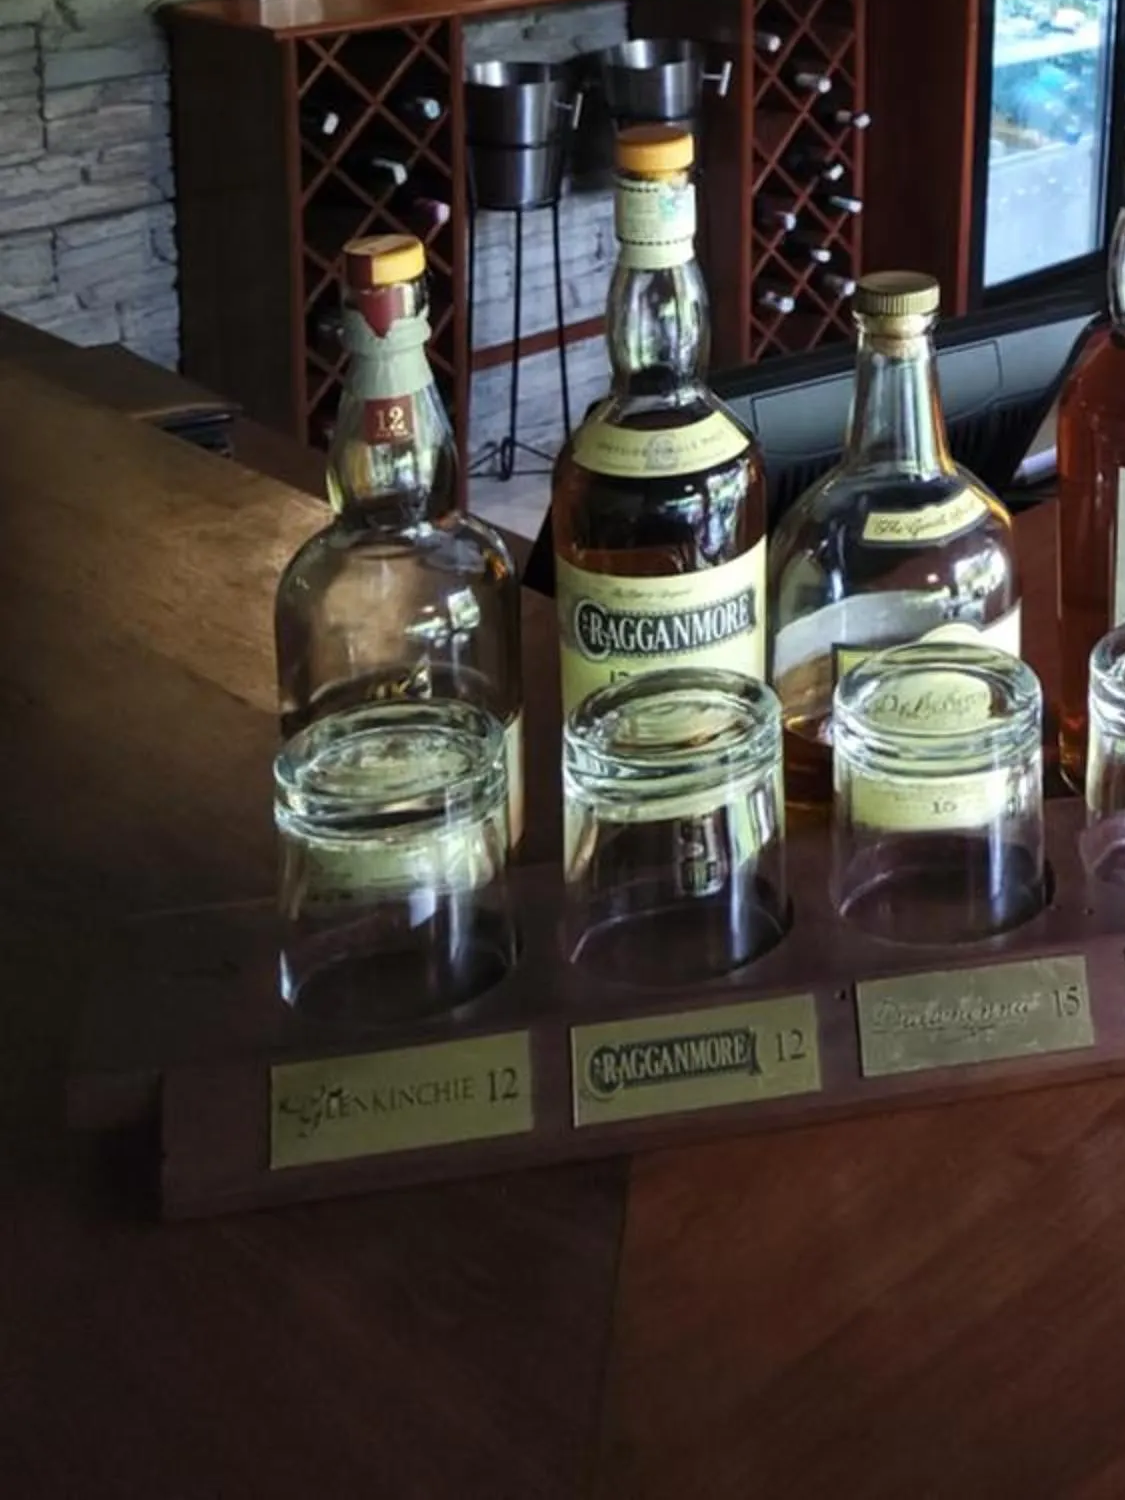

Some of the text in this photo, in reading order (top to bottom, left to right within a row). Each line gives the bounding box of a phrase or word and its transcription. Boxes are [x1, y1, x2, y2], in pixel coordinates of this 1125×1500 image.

[376, 406, 404, 431] 12
[574, 593, 749, 662] CRAGGANMORE
[1053, 985, 1081, 1019] 15
[776, 1028, 806, 1062] 12
[487, 1067, 519, 1104] 12
